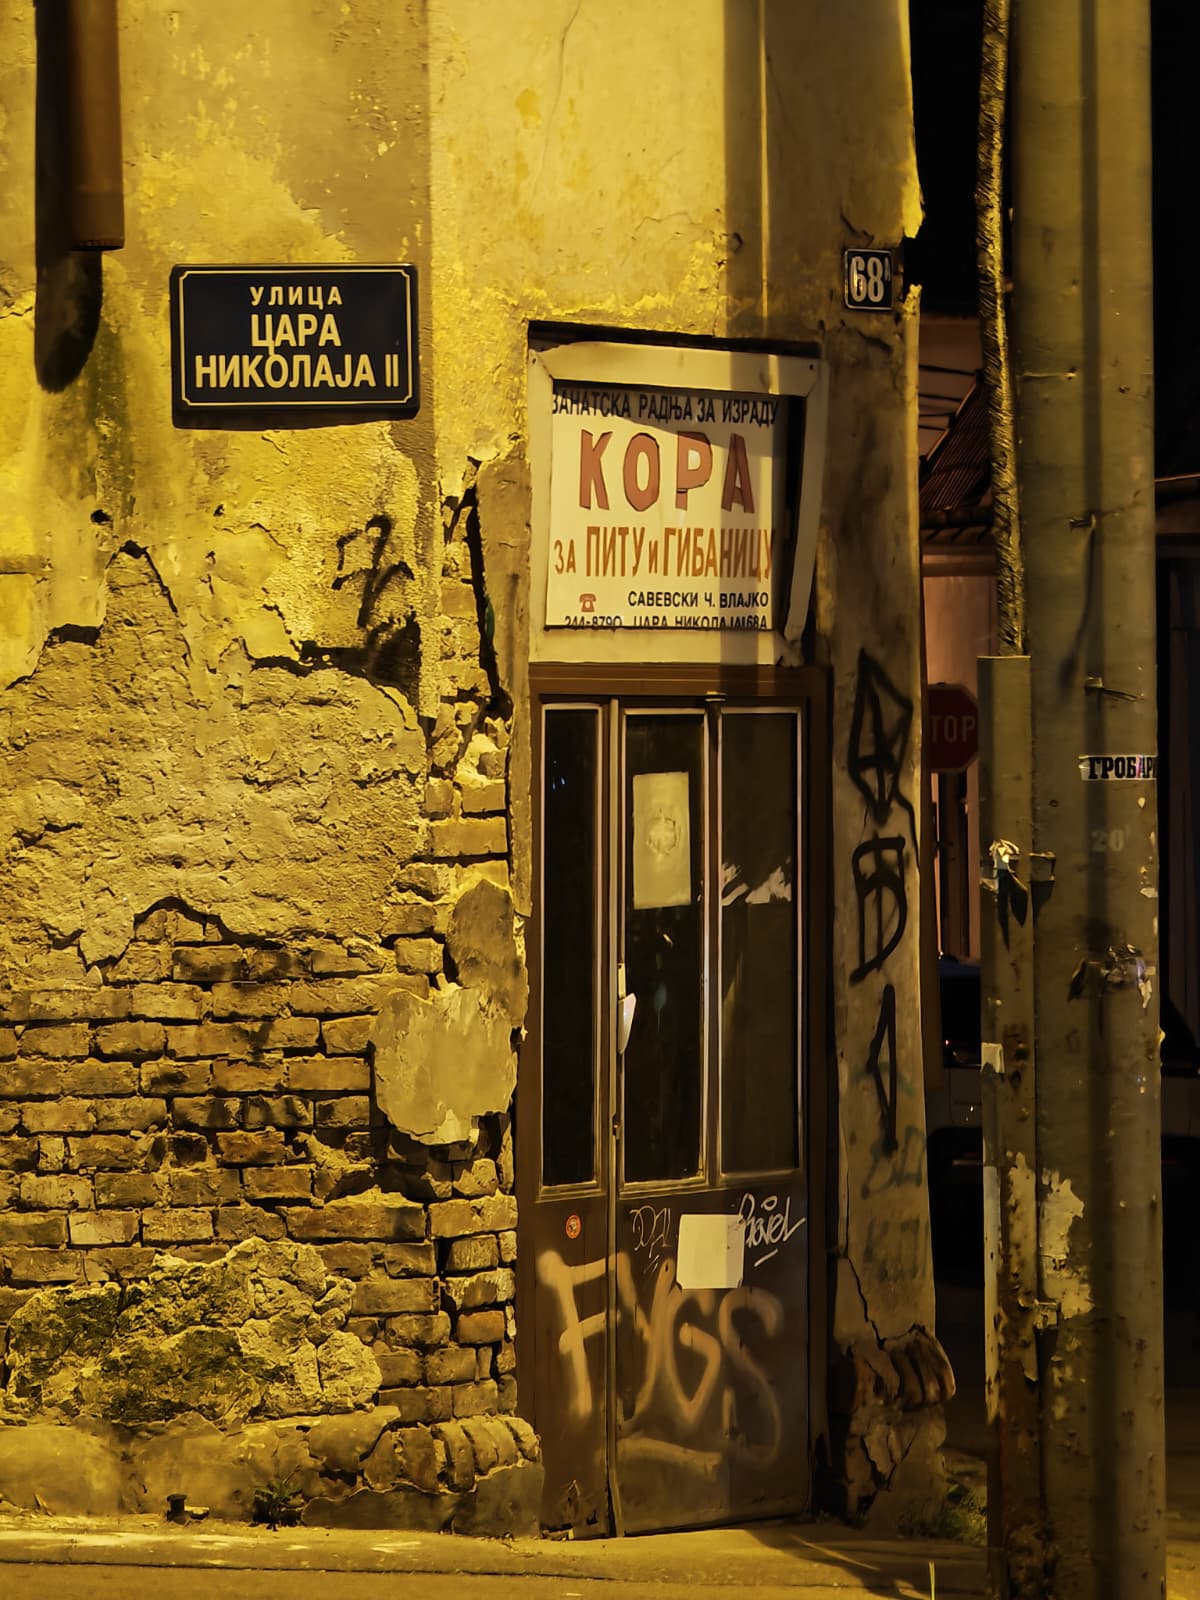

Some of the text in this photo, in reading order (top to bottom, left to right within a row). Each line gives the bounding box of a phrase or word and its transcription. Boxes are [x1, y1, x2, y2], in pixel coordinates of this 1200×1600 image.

[250, 286, 343, 310] УЛИЦА
[251, 314, 342, 356] ЦАРА
[195, 354, 399, 388] НИКОЛАЈА II
[638, 394, 693, 424] РАДЊА
[697, 398, 716, 423] ЗА
[722, 400, 778, 428] ИЗРАДУ
[579, 428, 756, 514] КОРА
[554, 538, 577, 574] ЗА
[586, 526, 646, 577] ПИТУ
[663, 526, 774, 582] ГИБАНИЦУ
[628, 591, 769, 608] САВЕВСКИ Ч. ВЛАЈКО
[929, 714, 977, 743] TOP
